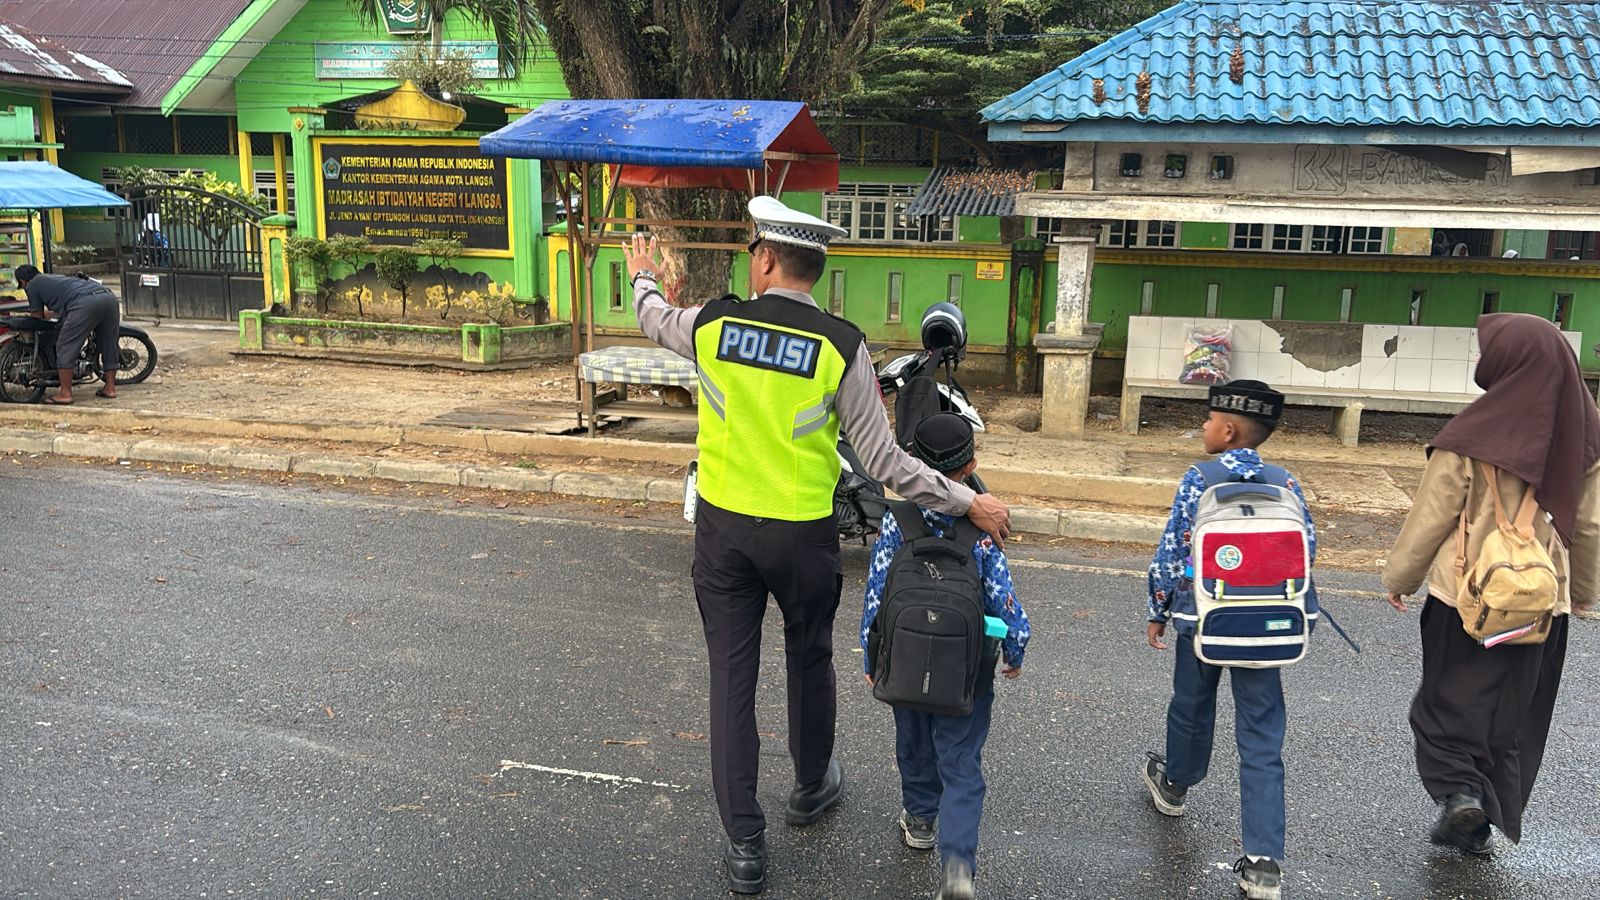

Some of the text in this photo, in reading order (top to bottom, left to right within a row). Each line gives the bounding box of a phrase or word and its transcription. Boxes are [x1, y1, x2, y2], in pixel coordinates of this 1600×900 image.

[341, 156, 495, 170] KEMENTERIAN AGAMA REPUBLIK INDONESIA
[342, 173, 495, 187] KANTOR KEMENTERIAN AGAMA KOTA LANGSA
[328, 189, 502, 209] MADRASAH IBTIDAIYAH NEGERI 1 LANGSA
[411, 213, 436, 223] LANGSA
[437, 214, 455, 224] KOTA
[720, 324, 816, 373] POLISI
